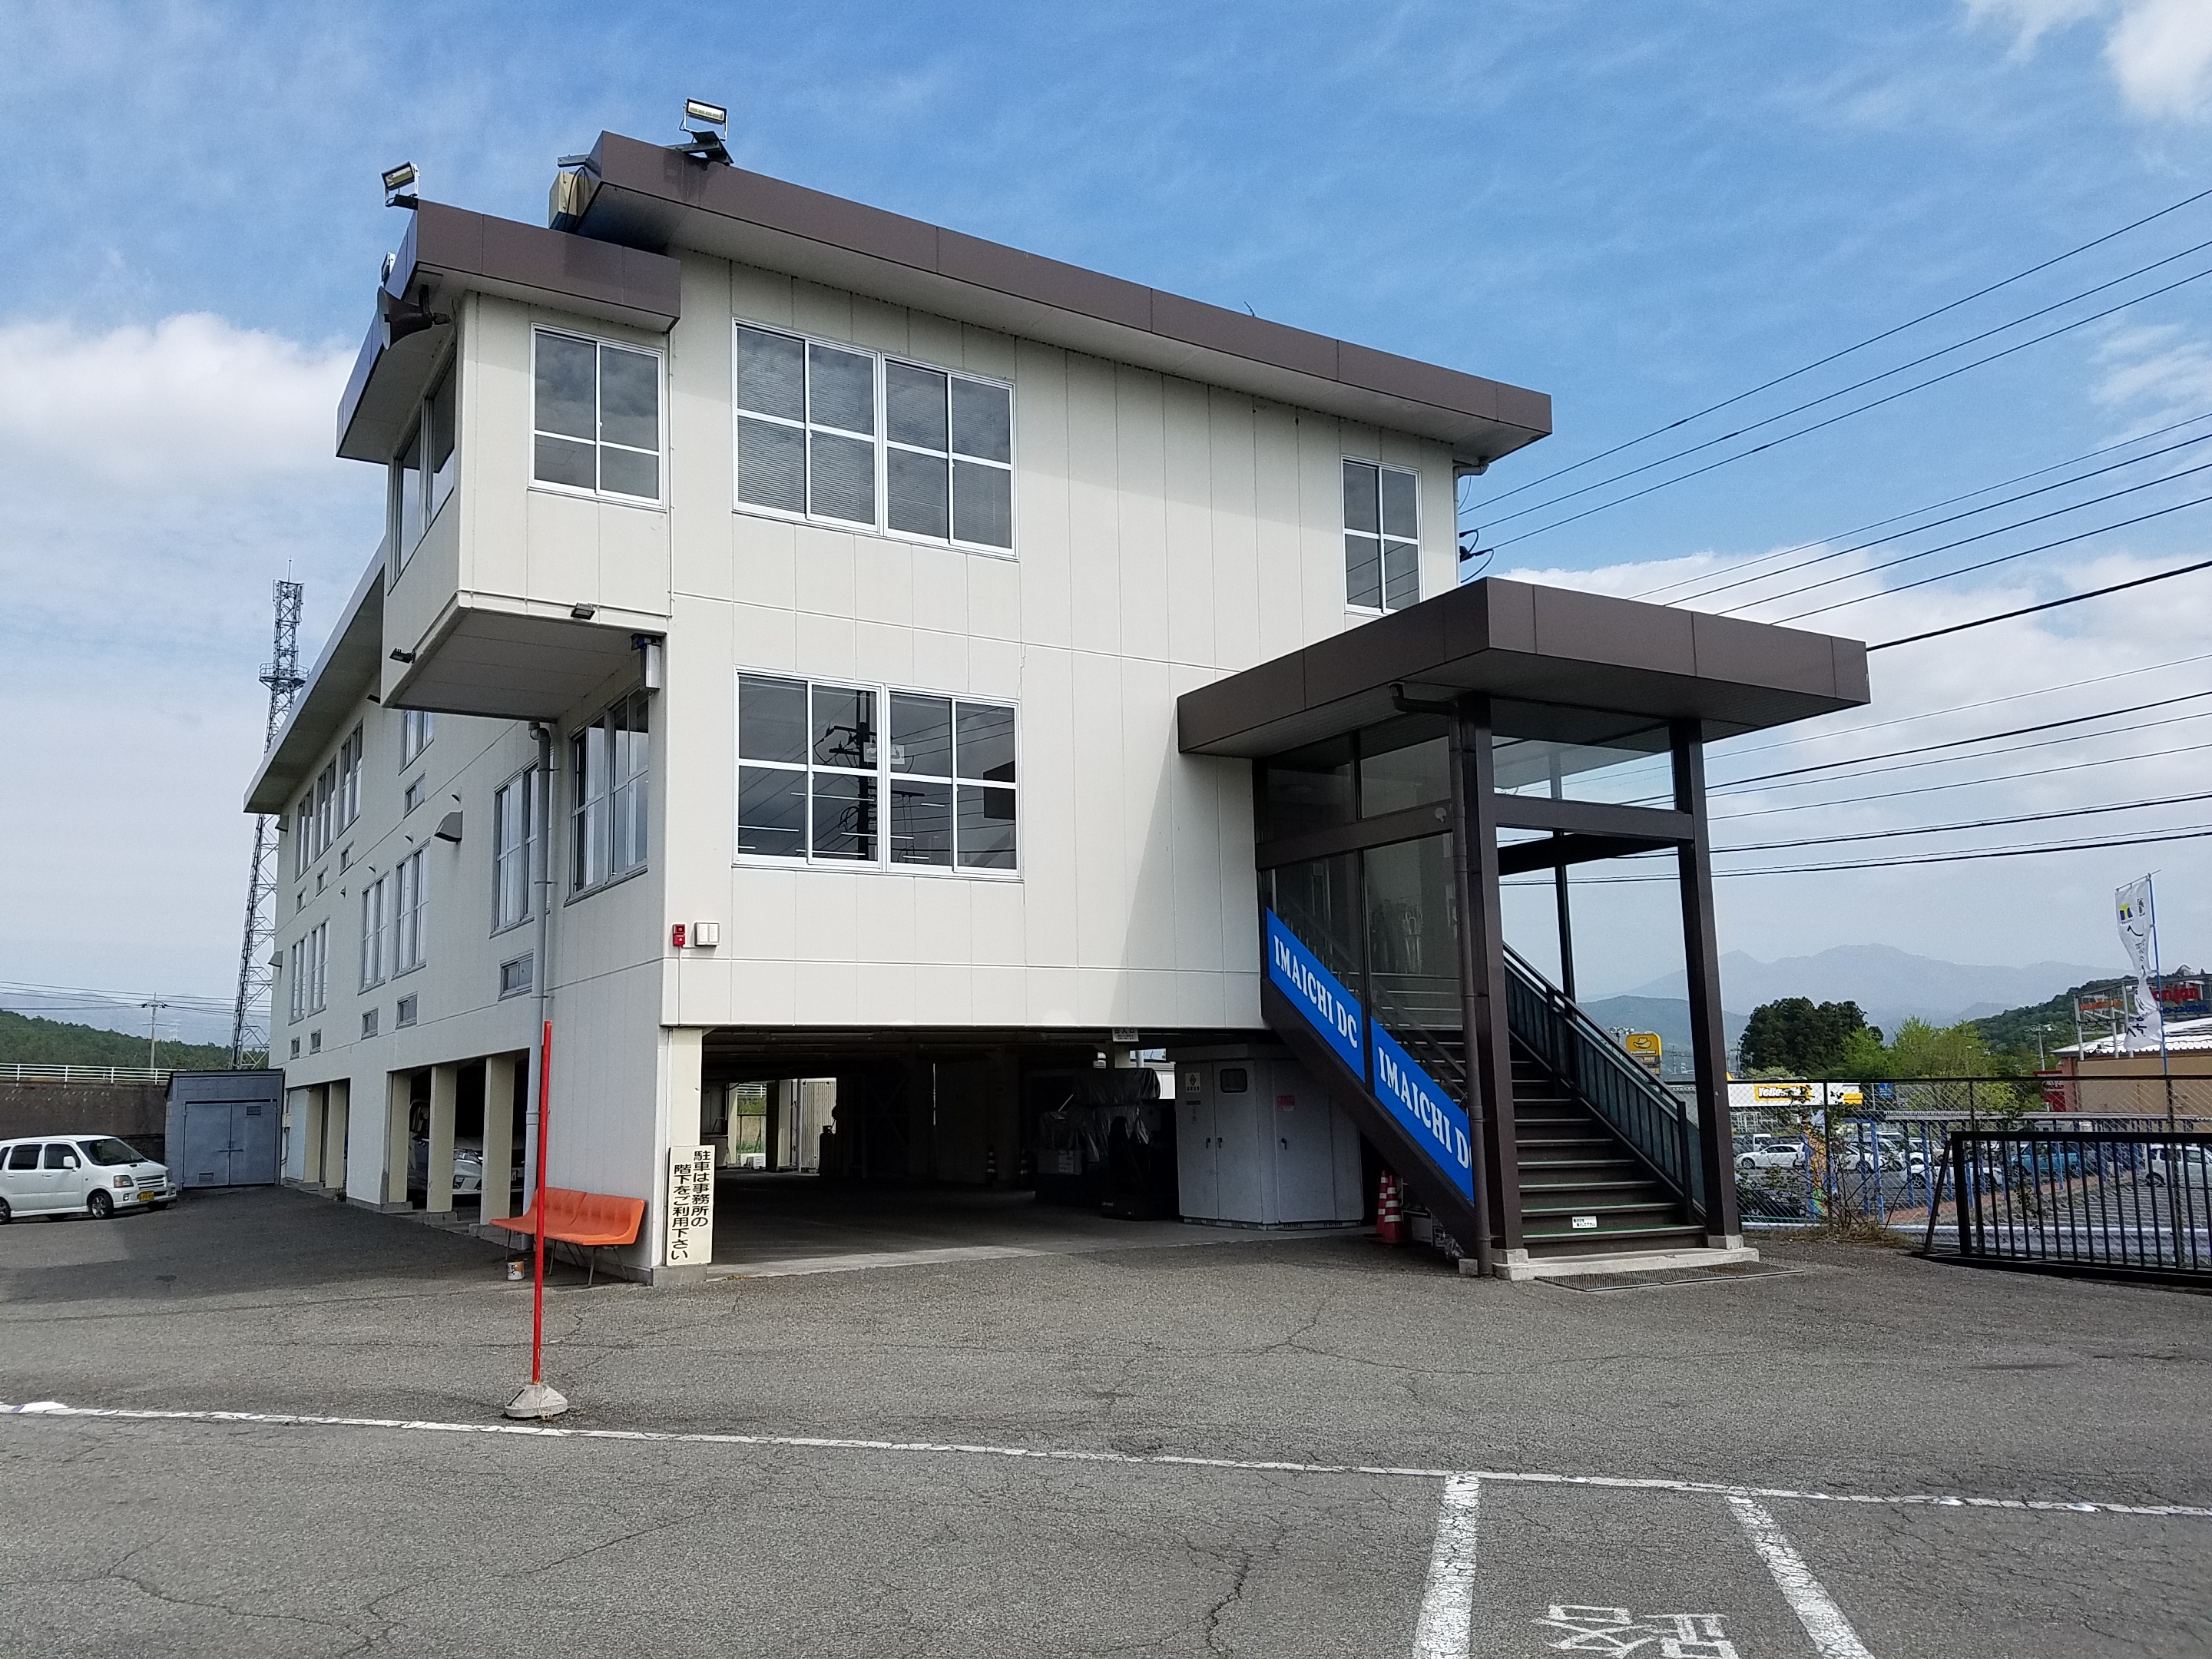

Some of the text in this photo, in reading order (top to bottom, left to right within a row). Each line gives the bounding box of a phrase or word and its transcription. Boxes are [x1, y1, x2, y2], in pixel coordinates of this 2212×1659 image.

[1273, 935, 1358, 1048] IMAICHI DC
[1378, 1046, 1472, 1169] IMAICHI D
[671, 1164, 691, 1260] 階下をご利用下さい
[691, 1150, 711, 1227] 駐車は事務所の
